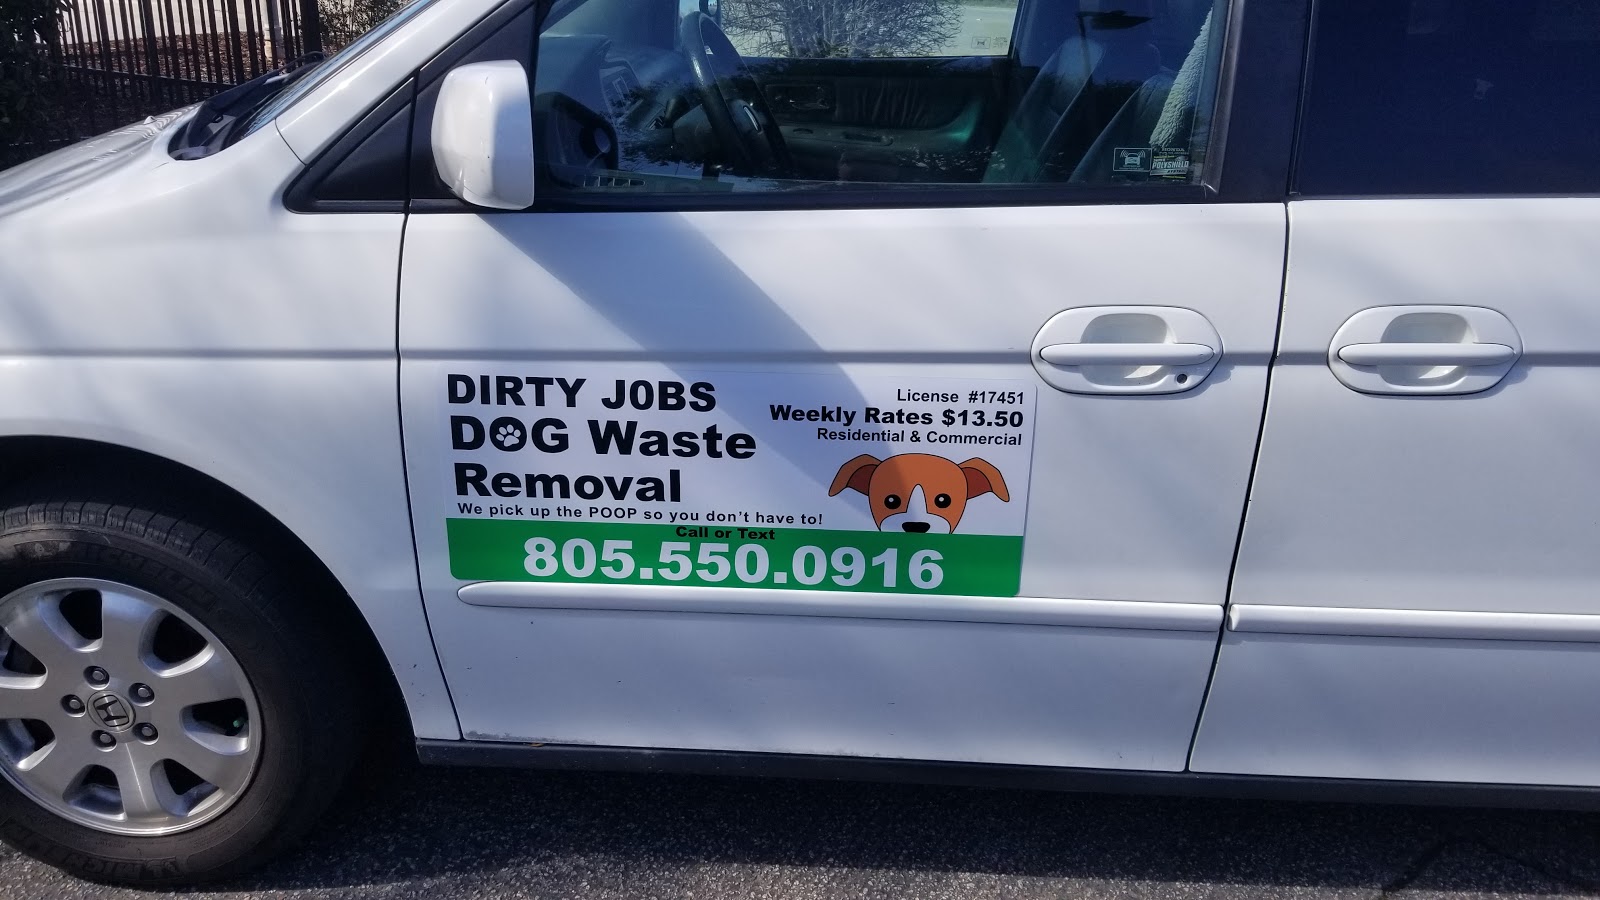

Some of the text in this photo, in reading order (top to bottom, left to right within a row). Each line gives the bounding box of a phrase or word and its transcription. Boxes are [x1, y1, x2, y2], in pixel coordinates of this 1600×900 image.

[447, 373, 587, 408] DIRTY
[897, 388, 1024, 405] License #17451
[769, 404, 1024, 428] Weekly Rates $13.50
[450, 414, 757, 460] DOG Waste
[817, 427, 1022, 446] Residential & Commercial
[454, 462, 681, 503] Removal
[458, 502, 823, 525] We pick up the POOP so you don't have to!
[675, 525, 776, 541] Call or Text
[523, 536, 945, 590] 805.550.0916
